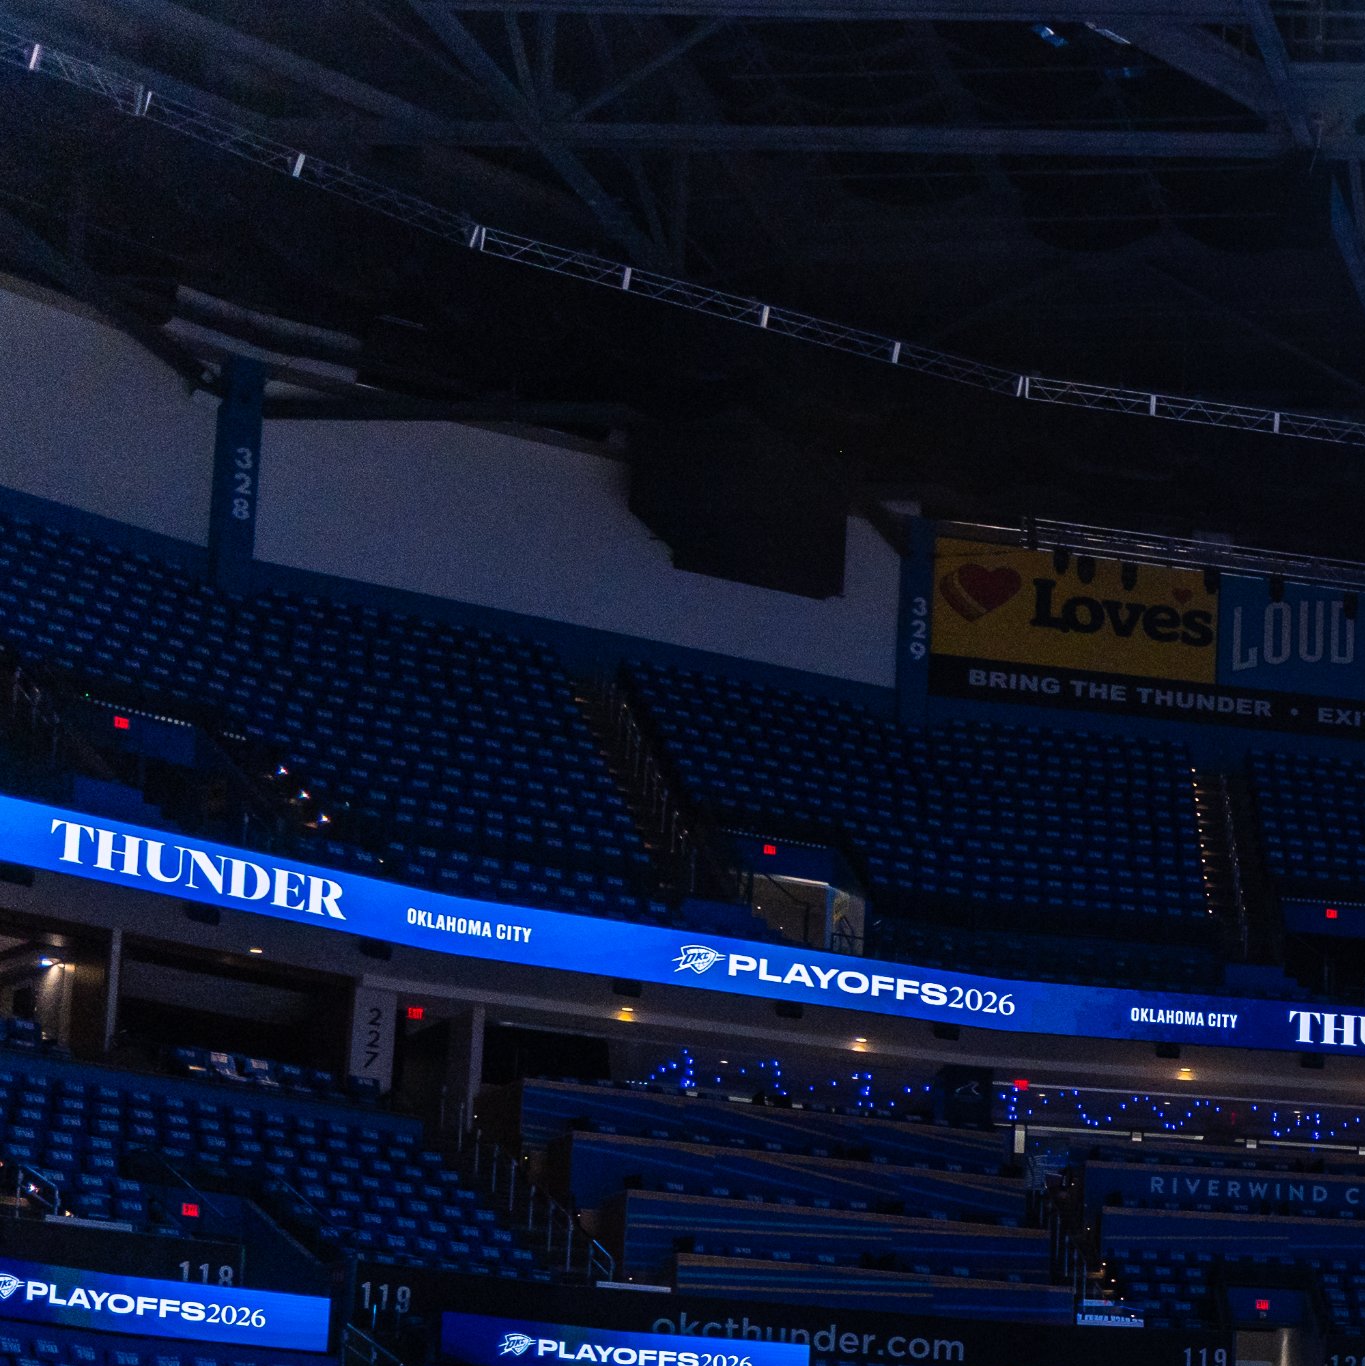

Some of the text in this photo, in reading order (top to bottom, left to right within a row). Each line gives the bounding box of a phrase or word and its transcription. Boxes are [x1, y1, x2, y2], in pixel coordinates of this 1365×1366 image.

[232, 447, 252, 521] 328
[910, 597, 927, 659] 329
[1232, 601, 1354, 670] LOUD
[969, 664, 1064, 693] BRING
[1070, 680, 1126, 701] THE
[1137, 688, 1271, 716] THUNDER
[51, 819, 346, 920] THUNDER
[407, 908, 532, 943] OKLAHOMA CITY
[366, 1007, 382, 1068] 227
[1131, 1008, 1237, 1028] OKLAHOMA CITY
[1151, 1175, 1329, 1202] RIVERWIND
[179, 1261, 234, 1287] 118
[361, 1281, 411, 1314] 119
